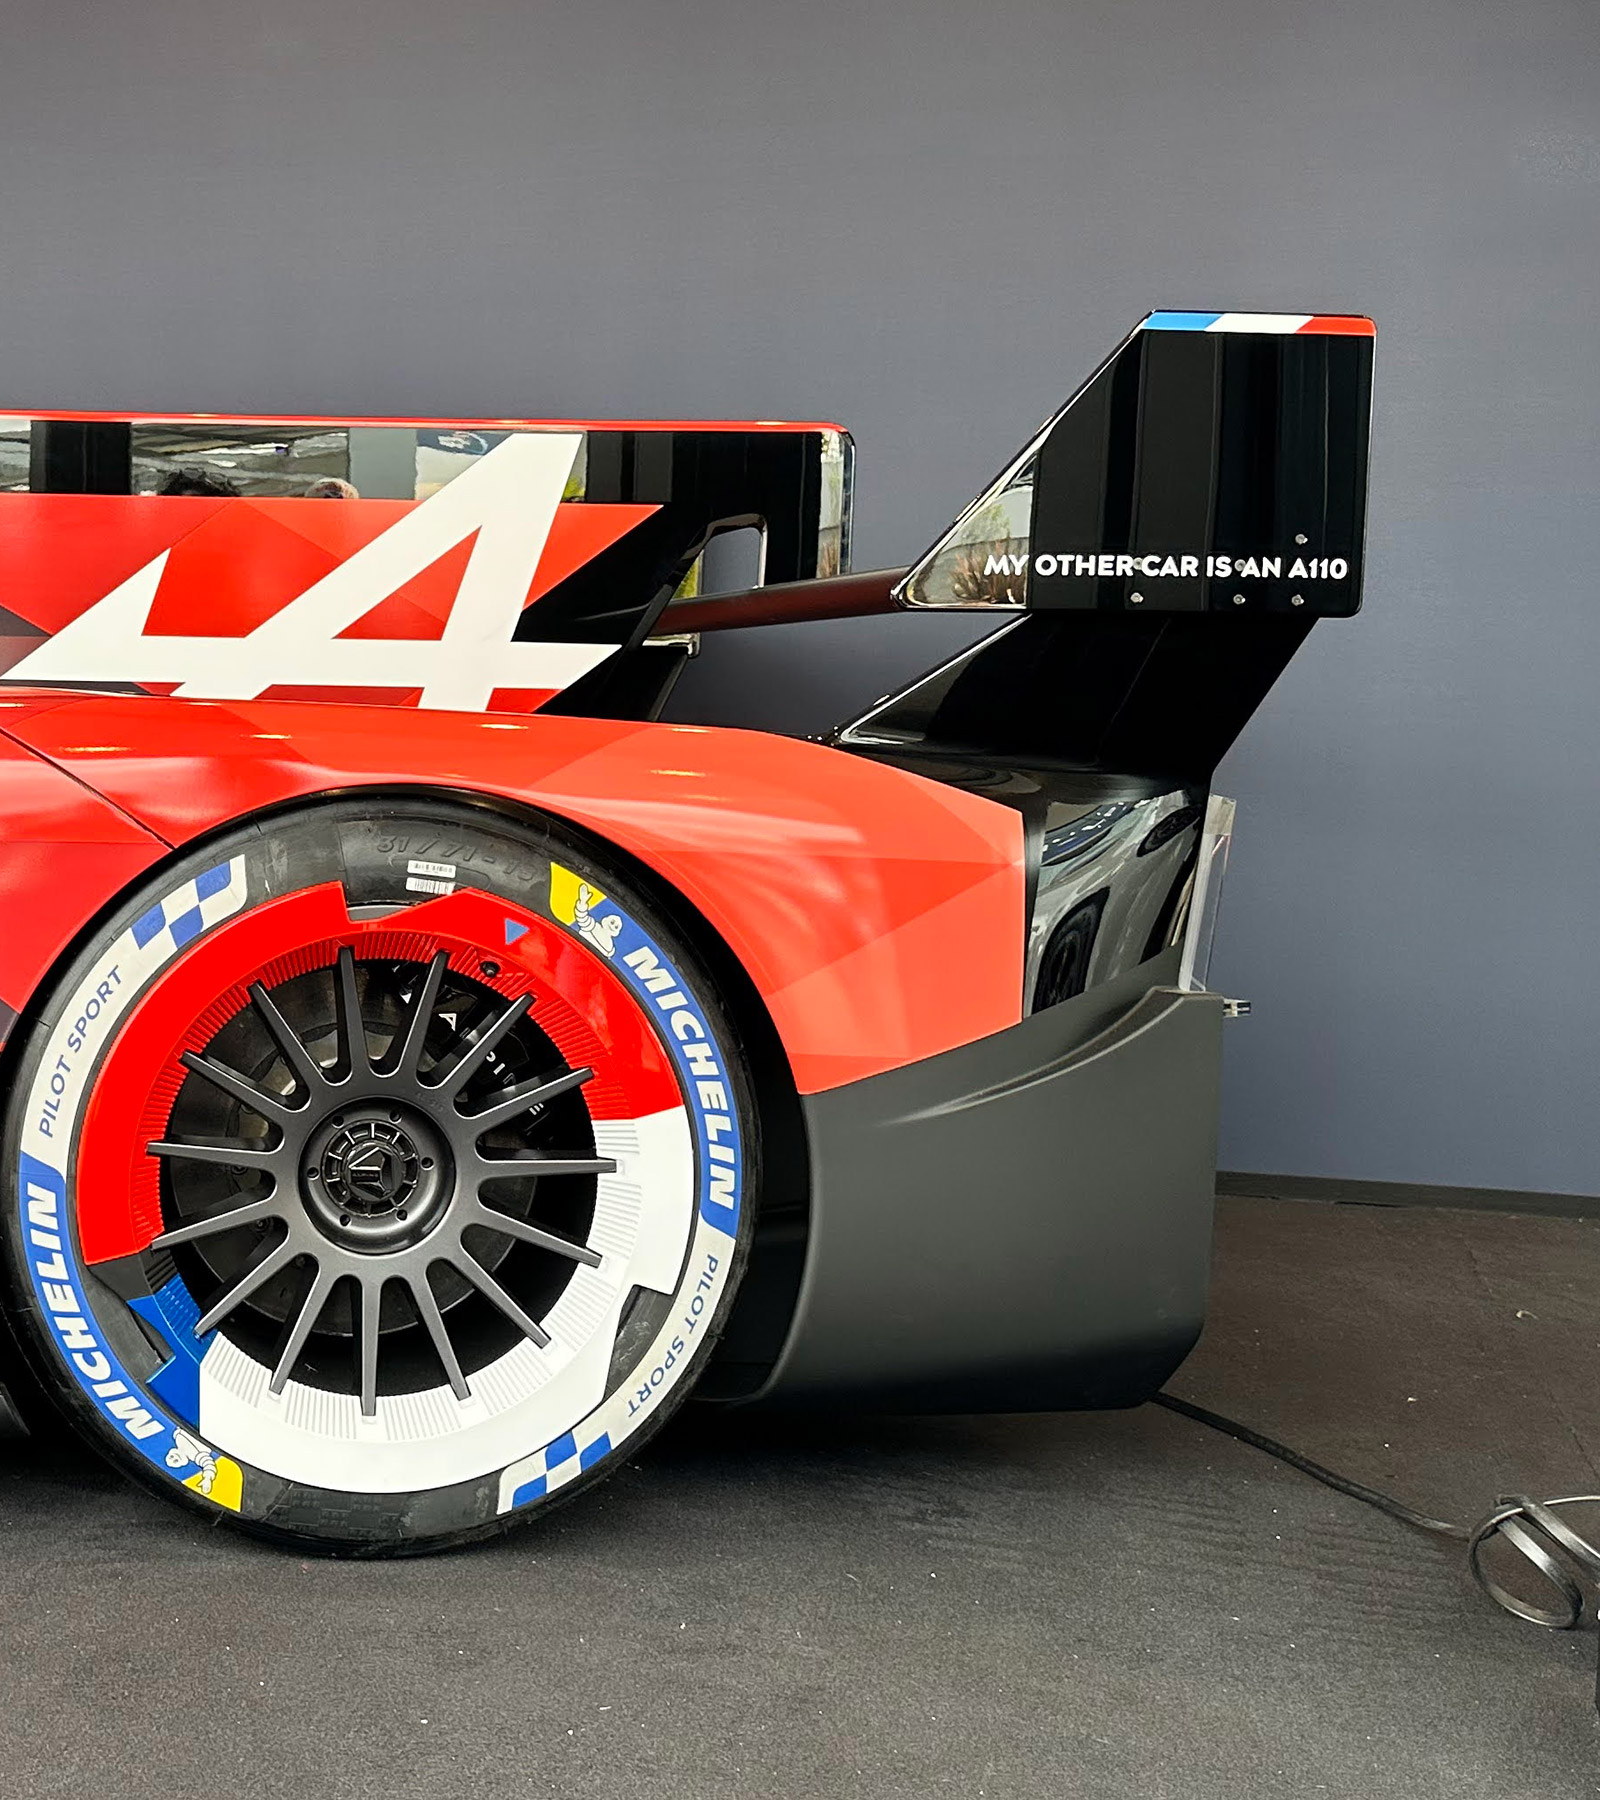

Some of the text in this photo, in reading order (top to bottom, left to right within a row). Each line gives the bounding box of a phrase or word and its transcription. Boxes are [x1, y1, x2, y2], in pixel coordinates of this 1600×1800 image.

[983, 555, 1348, 579] MY OTHER CAR IS AN A110
[39, 965, 122, 1138] PILOT SPORT
[622, 946, 736, 1210] MICHELIN
[27, 1182, 165, 1440] MICHELIN
[628, 1254, 719, 1417] PILOT SPORT
